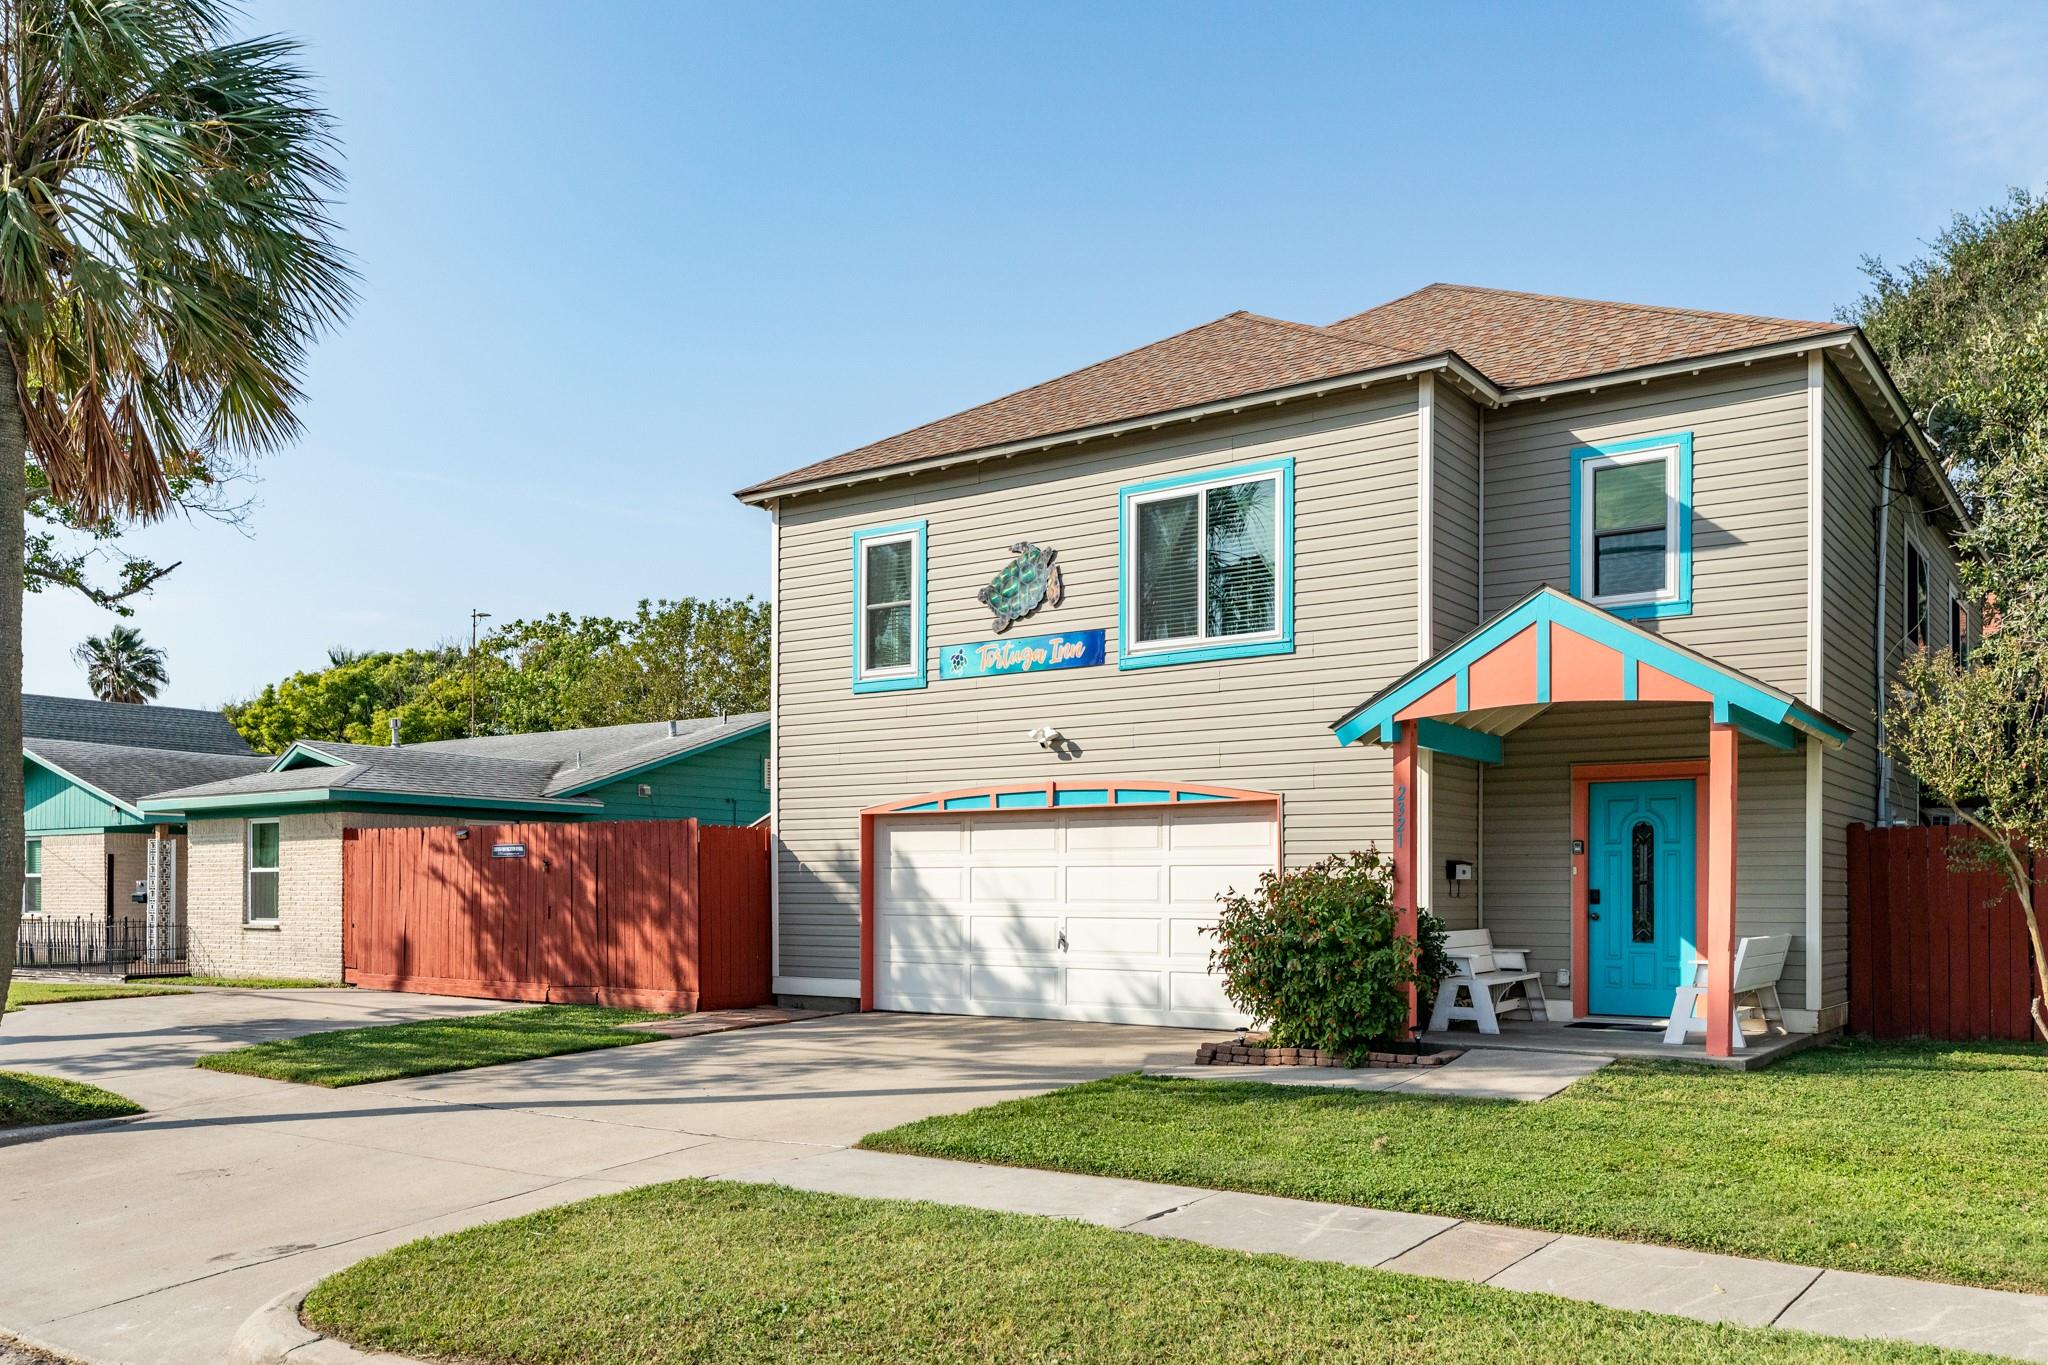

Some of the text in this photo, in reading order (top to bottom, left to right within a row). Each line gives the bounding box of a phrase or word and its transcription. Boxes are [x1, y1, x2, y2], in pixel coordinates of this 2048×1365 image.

[977, 638, 1085, 670] Tortuga Inn
[1394, 784, 1406, 848] 2321
